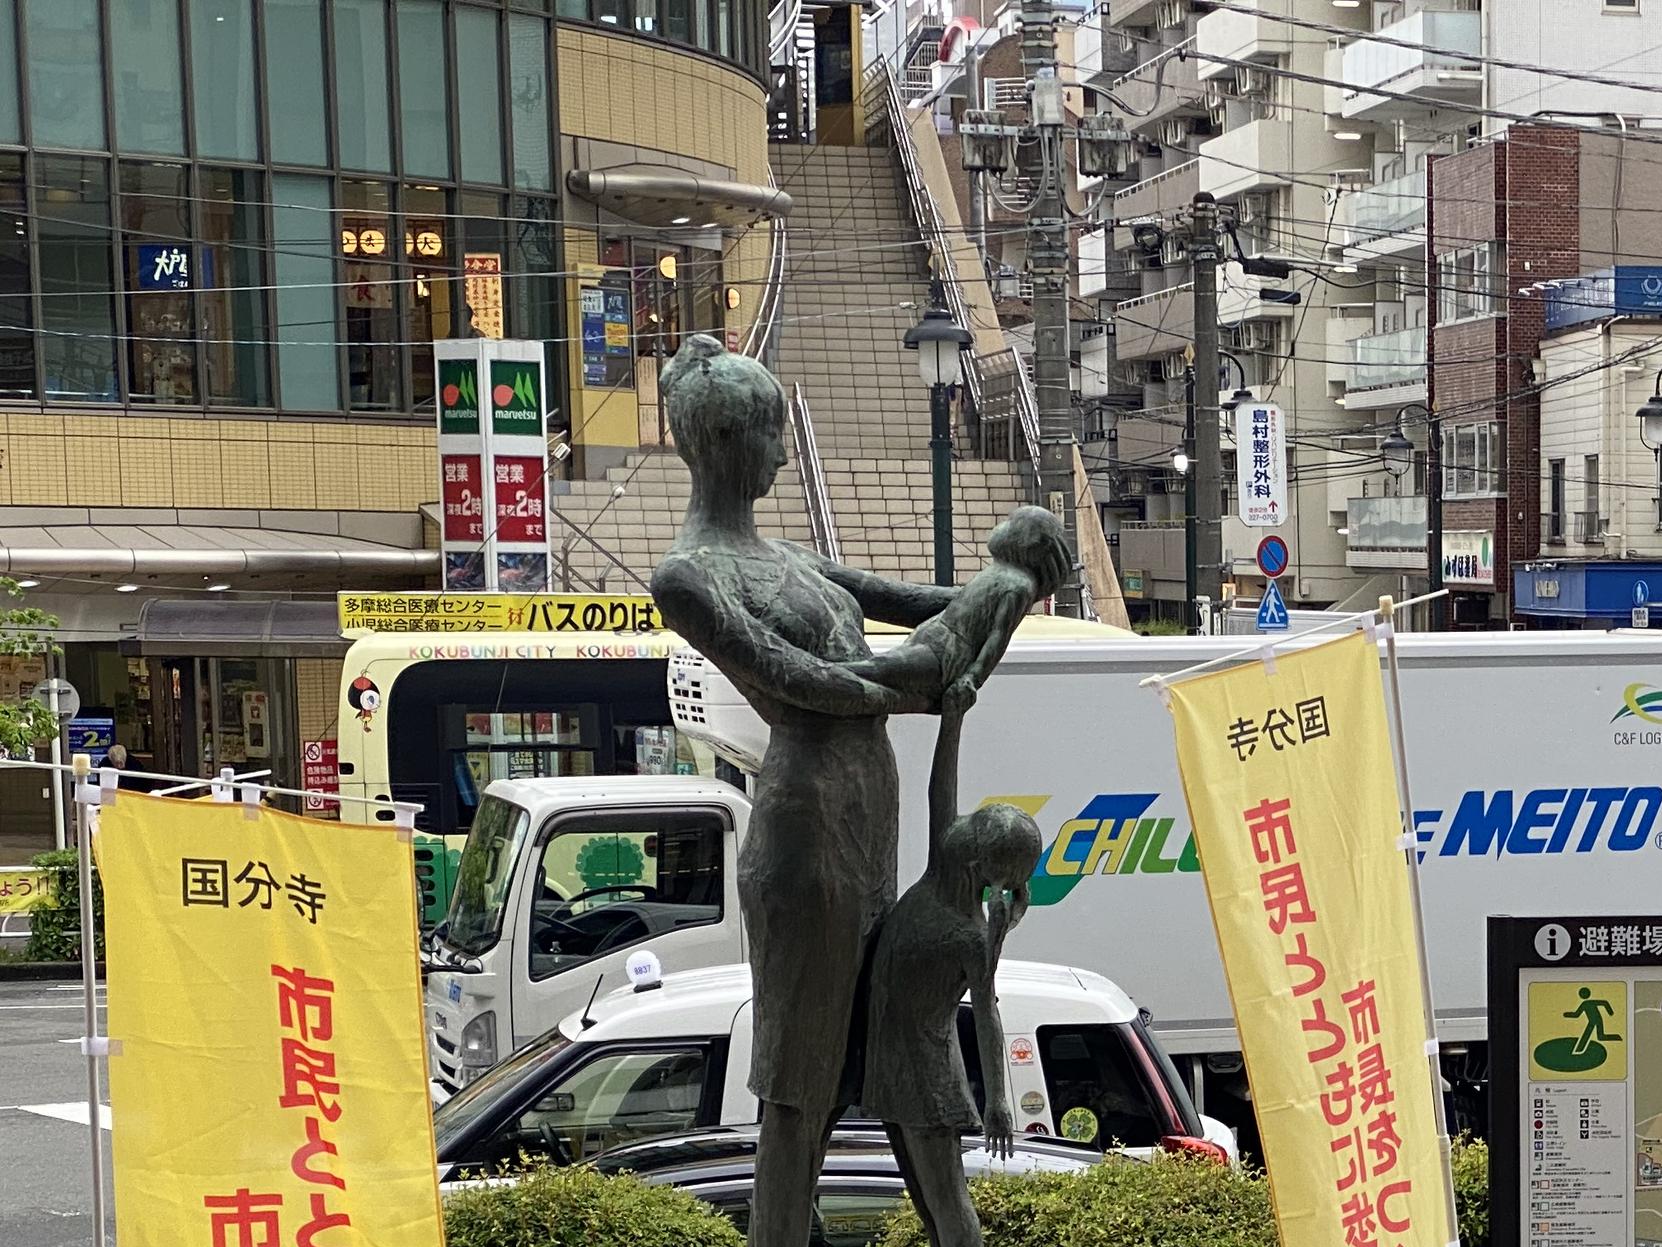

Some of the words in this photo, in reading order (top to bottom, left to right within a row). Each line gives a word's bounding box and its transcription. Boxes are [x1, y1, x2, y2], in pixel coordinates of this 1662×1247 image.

[445, 409, 477, 419] maruetsu
[495, 409, 537, 420] maruetsu
[1252, 409, 1271, 498] 島村整形外科
[445, 463, 469, 482] 営業
[496, 464, 525, 483] 営業
[497, 490, 542, 518] 深夜2時
[469, 523, 482, 534] まで
[525, 523, 542, 535] まで
[344, 598, 502, 614] 多摩総合医療センター
[528, 602, 655, 632] バスのりば
[409, 644, 509, 660] KOKUBUNJI
[515, 644, 557, 659] CITY
[575, 644, 671, 660] KOKUBUNJ
[1613, 731, 1638, 745] C&F
[181, 857, 328, 925] 国分寺
